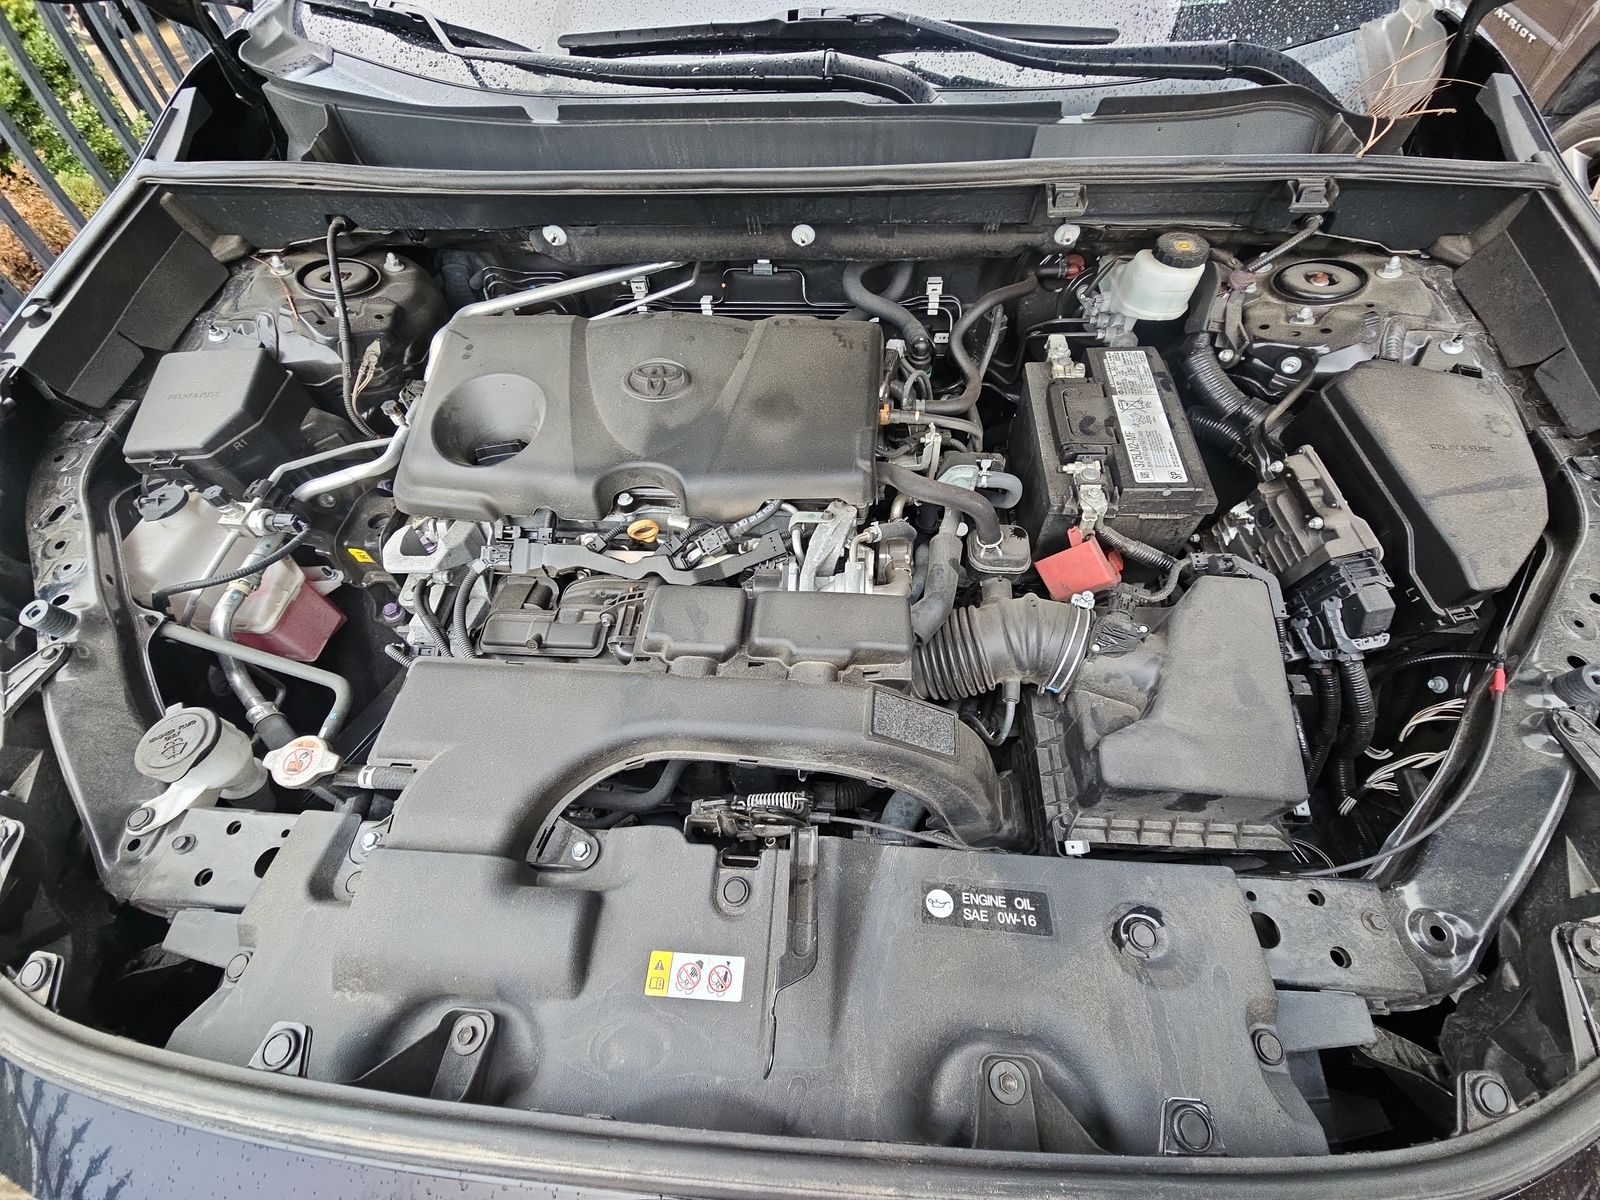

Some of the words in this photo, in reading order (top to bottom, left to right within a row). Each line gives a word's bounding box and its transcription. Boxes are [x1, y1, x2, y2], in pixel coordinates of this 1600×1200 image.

[1492, 7, 1537, 44] ATRIOT
[232, 439, 248, 451] R1
[1169, 471, 1182, 480] SP
[961, 892, 1007, 908] ENGINE
[1014, 897, 1036, 911] OIL
[963, 908, 989, 922] SAE
[997, 911, 1037, 927] 0W-16
